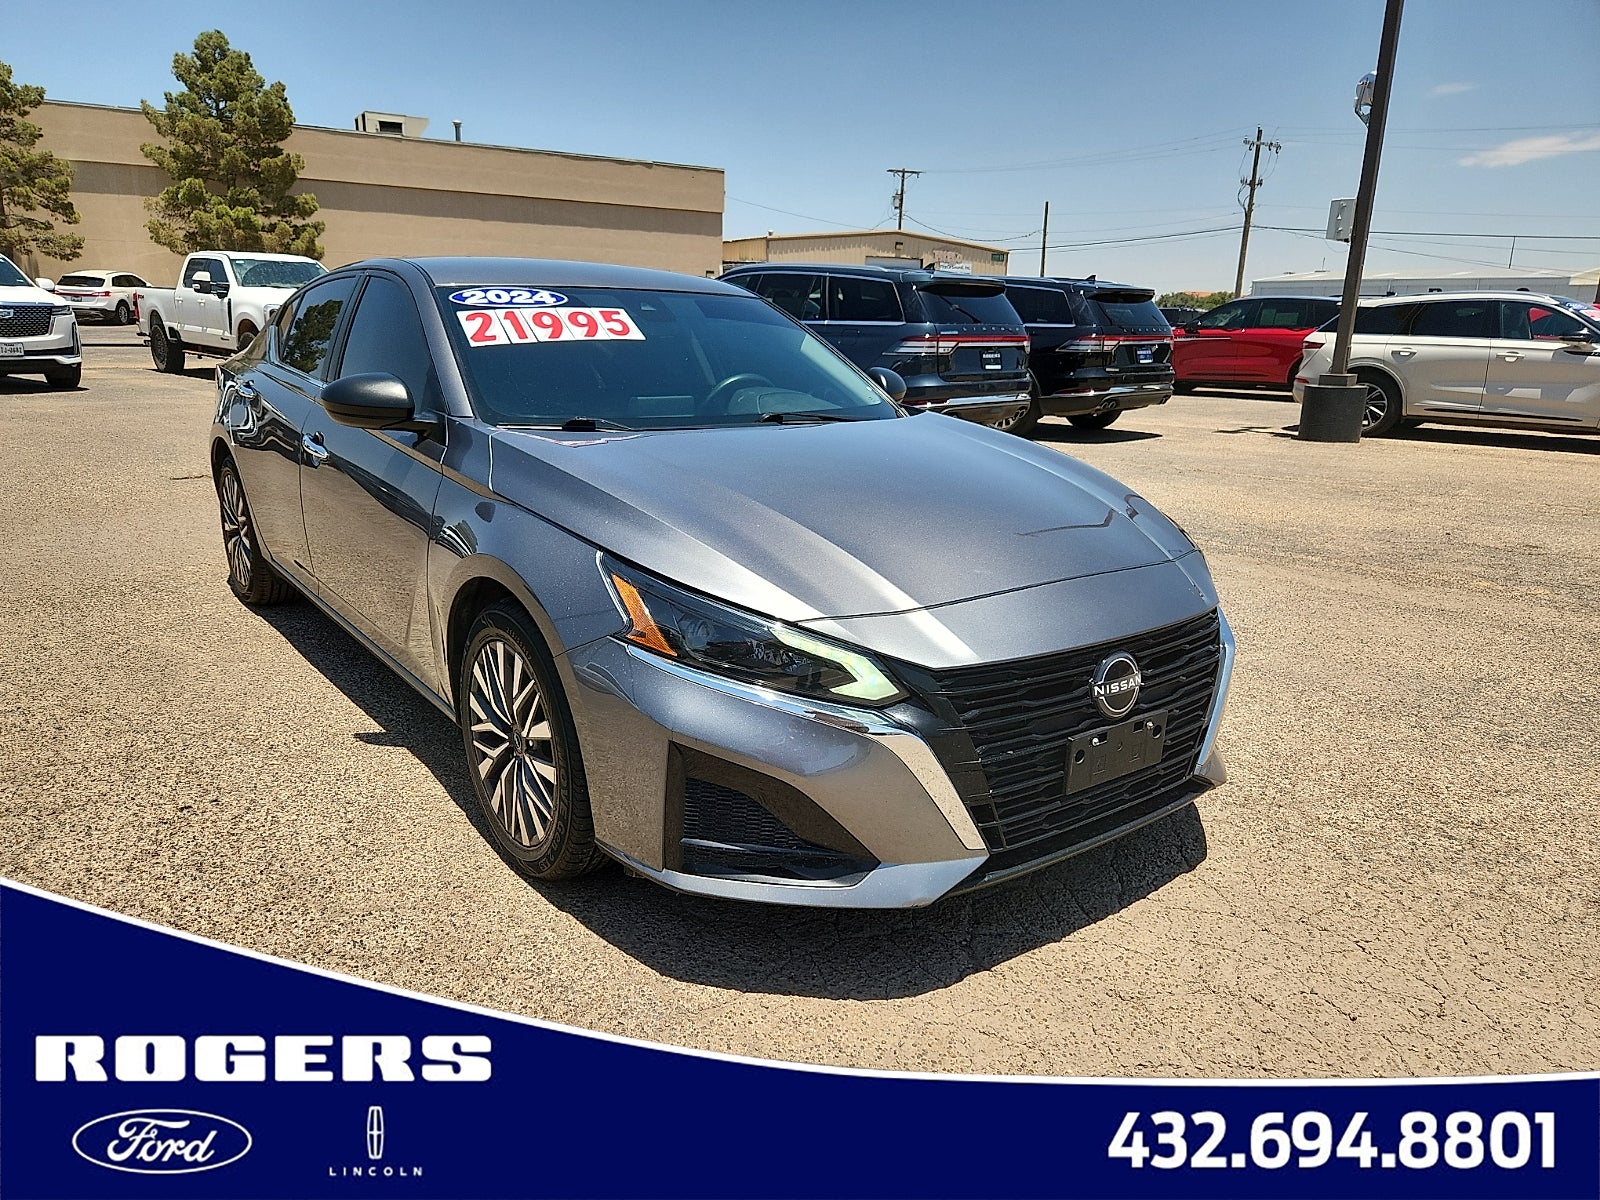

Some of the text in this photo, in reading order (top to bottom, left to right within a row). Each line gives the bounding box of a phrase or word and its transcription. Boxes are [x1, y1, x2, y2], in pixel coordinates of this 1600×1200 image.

[462, 289, 556, 304] 2024
[465, 311, 630, 342] 21995
[1094, 676, 1141, 696] NISSAN
